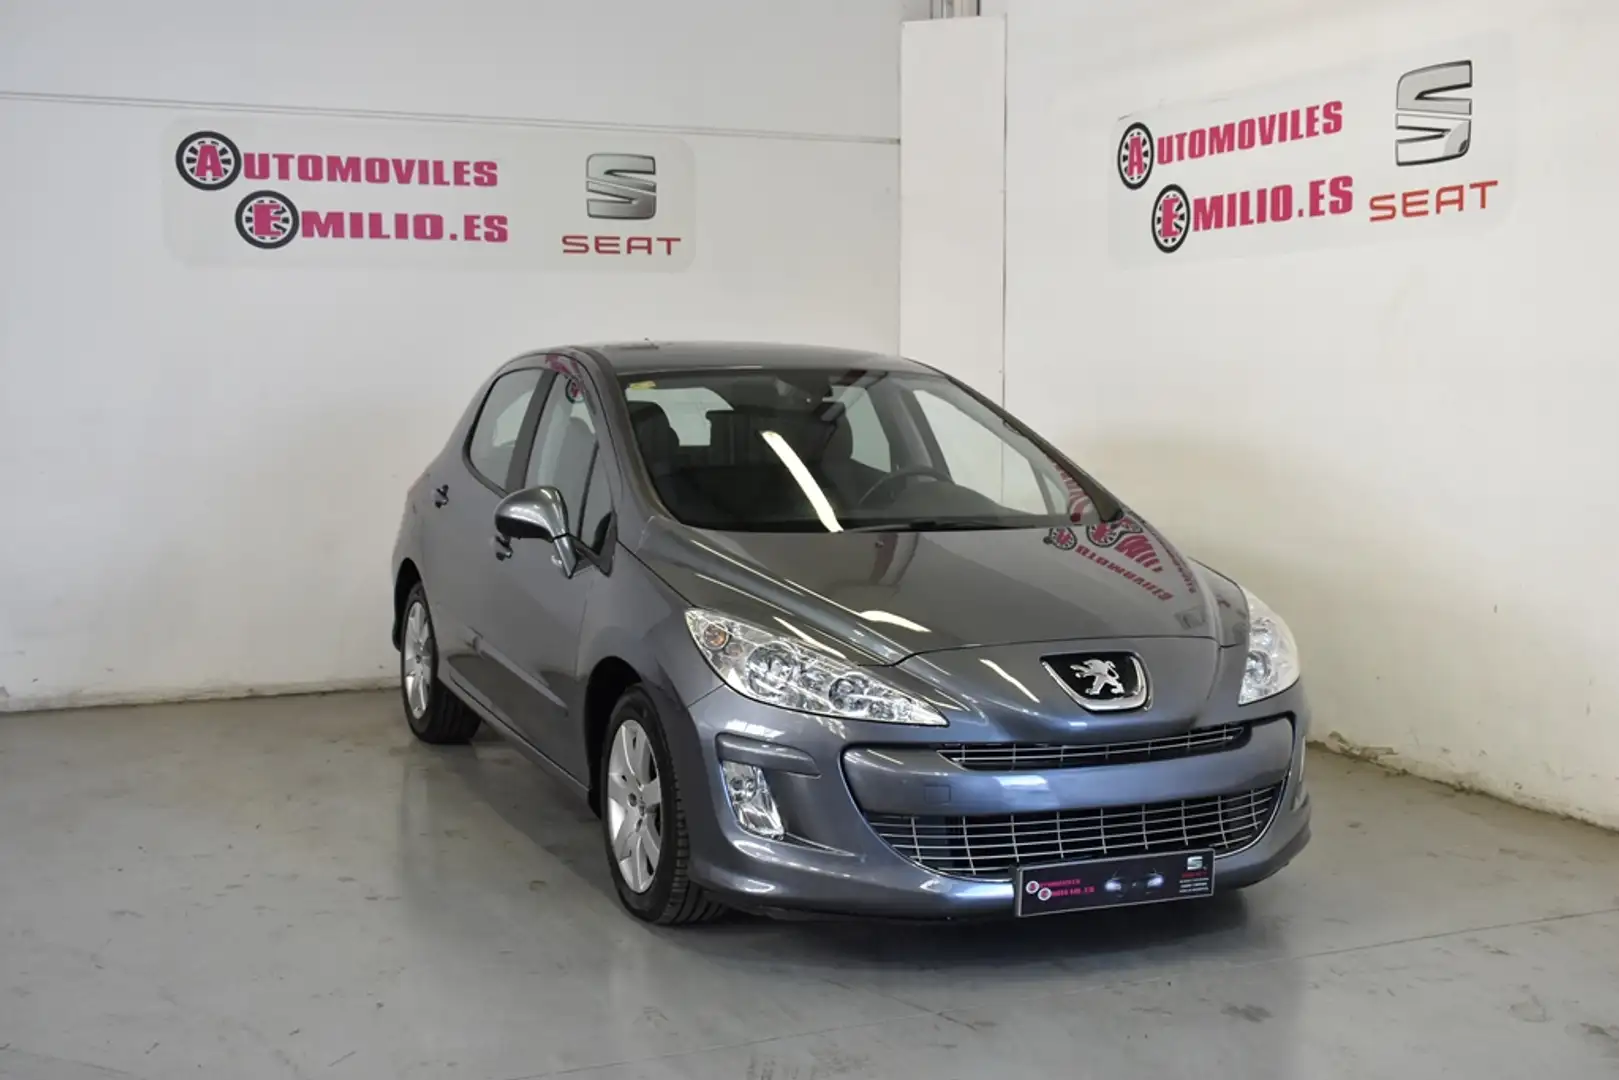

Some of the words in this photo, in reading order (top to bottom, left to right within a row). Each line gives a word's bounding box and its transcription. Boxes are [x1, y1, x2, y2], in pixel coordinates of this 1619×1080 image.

[1127, 100, 1344, 177] AUTOMOVILES
[195, 144, 498, 187] AUTOMOVILES
[1160, 175, 1354, 238] EMILIO.ES
[1368, 179, 1499, 223] SEAT
[252, 203, 509, 243] EMILIO.ES
[562, 235, 682, 256] SEAT
